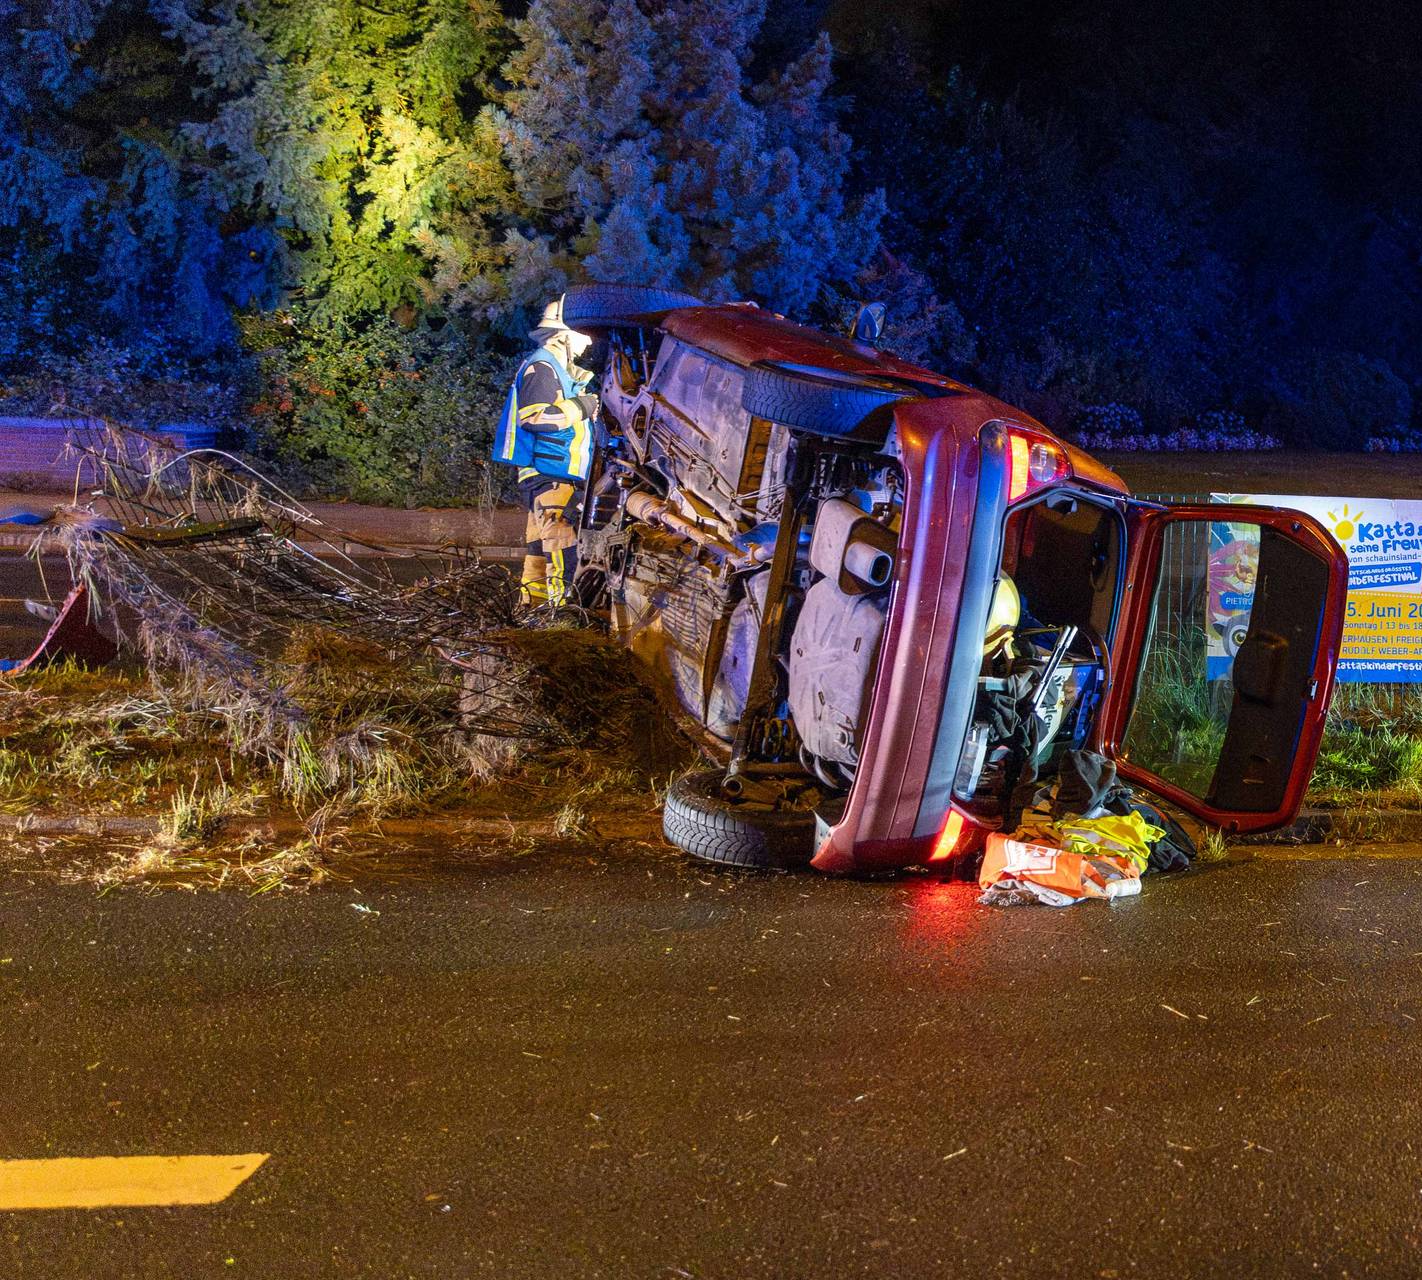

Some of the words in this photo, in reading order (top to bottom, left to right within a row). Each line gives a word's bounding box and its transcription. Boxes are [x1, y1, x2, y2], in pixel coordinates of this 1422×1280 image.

[1358, 521, 1415, 542] Katta
[1350, 543, 1379, 554] seine
[1349, 568, 1384, 576] EUTSCHLANDS
[1349, 572, 1418, 586] NDERFESTIVAL
[1347, 601, 1361, 617] 5.
[1367, 602, 1402, 618] Juni
[1343, 621, 1377, 630] Sonntag
[1399, 622, 1410, 630] bis
[1413, 622, 1422, 630] 18
[1342, 635, 1388, 644] ERHAUSEN
[1342, 646, 1376, 655] RUDOLF
